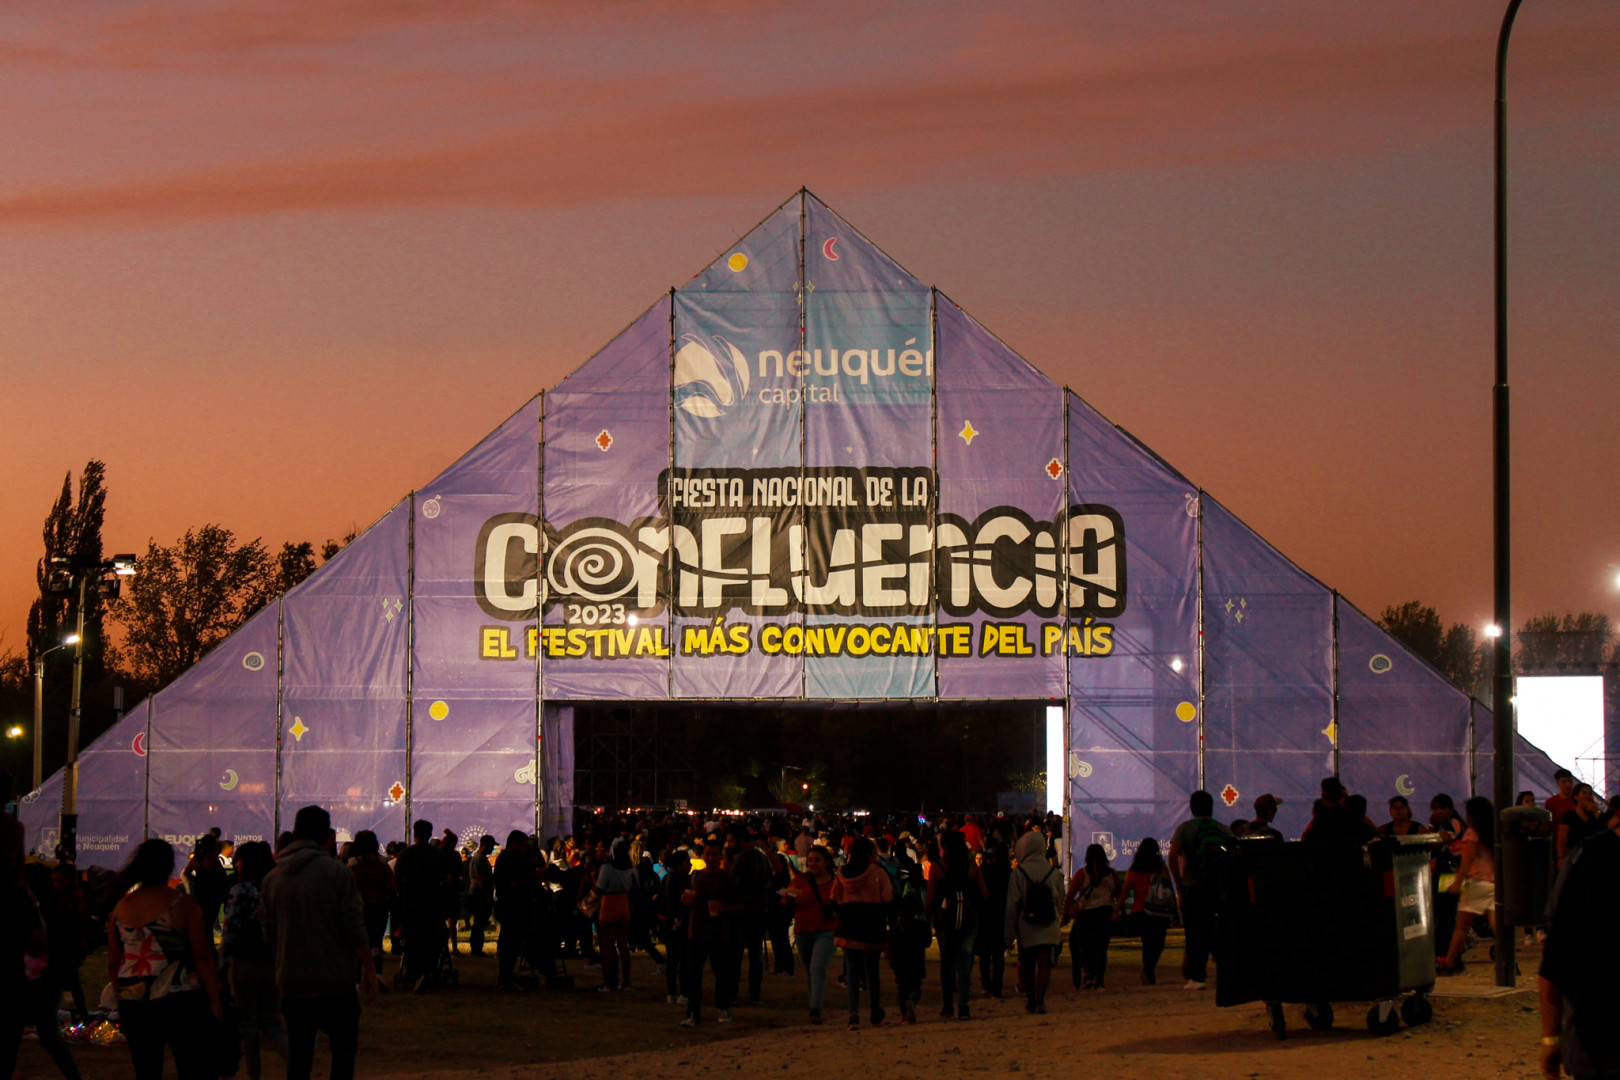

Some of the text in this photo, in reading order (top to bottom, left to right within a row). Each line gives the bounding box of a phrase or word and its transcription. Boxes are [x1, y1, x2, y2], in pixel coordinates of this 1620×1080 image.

[759, 383, 839, 410] capital
[672, 476, 928, 508] FIESTA NACIONAL DE LA
[568, 603, 626, 625] 2023
[483, 617, 1114, 658] EL FESTIVAL MÁS CONVOCANTE DEL PAÍS
